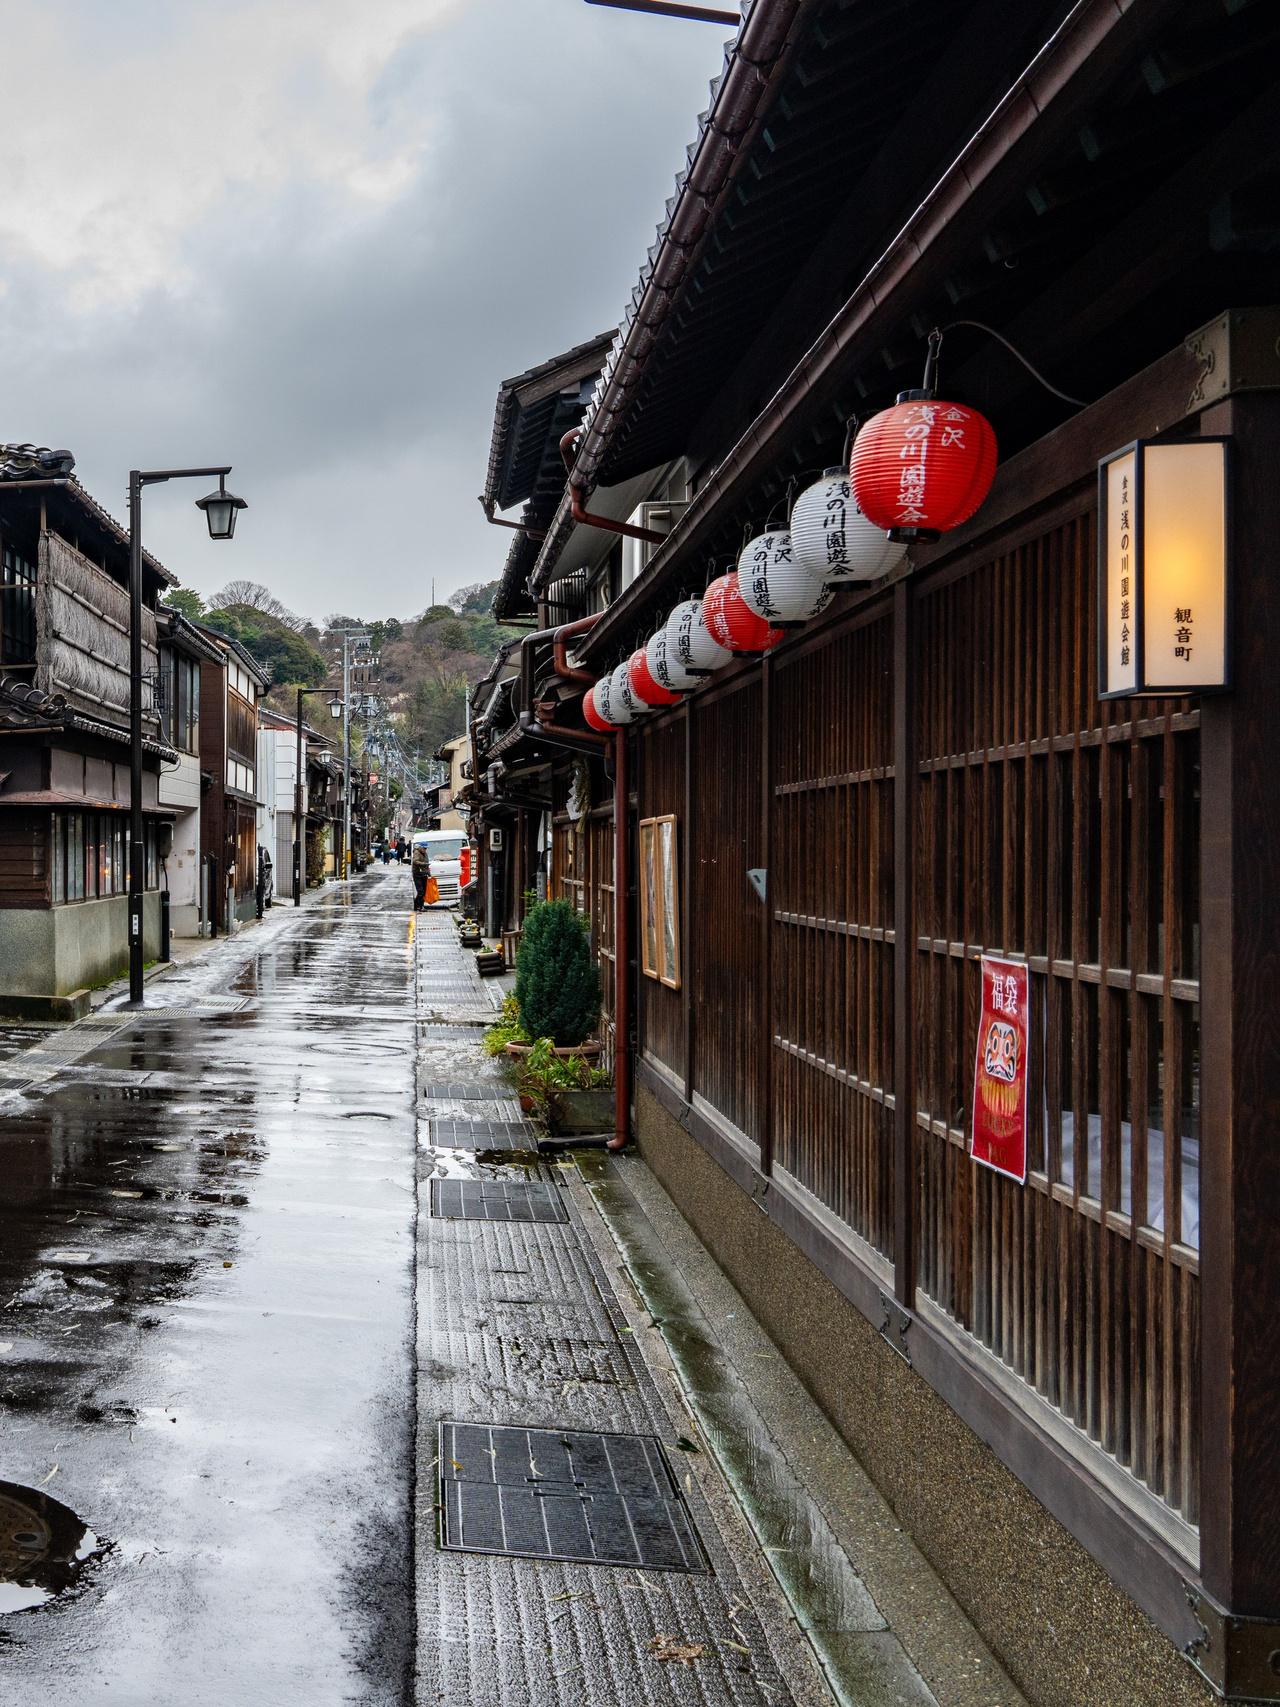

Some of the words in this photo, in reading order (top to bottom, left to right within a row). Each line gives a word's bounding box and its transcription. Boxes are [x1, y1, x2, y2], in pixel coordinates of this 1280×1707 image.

[940, 406, 971, 450] 金沢
[894, 405, 941, 523] 浅の川園遊会
[823, 480, 854, 576] 浅の川園遊会
[1174, 607, 1194, 662] 観音町
[991, 971, 1018, 1015] 福袋
